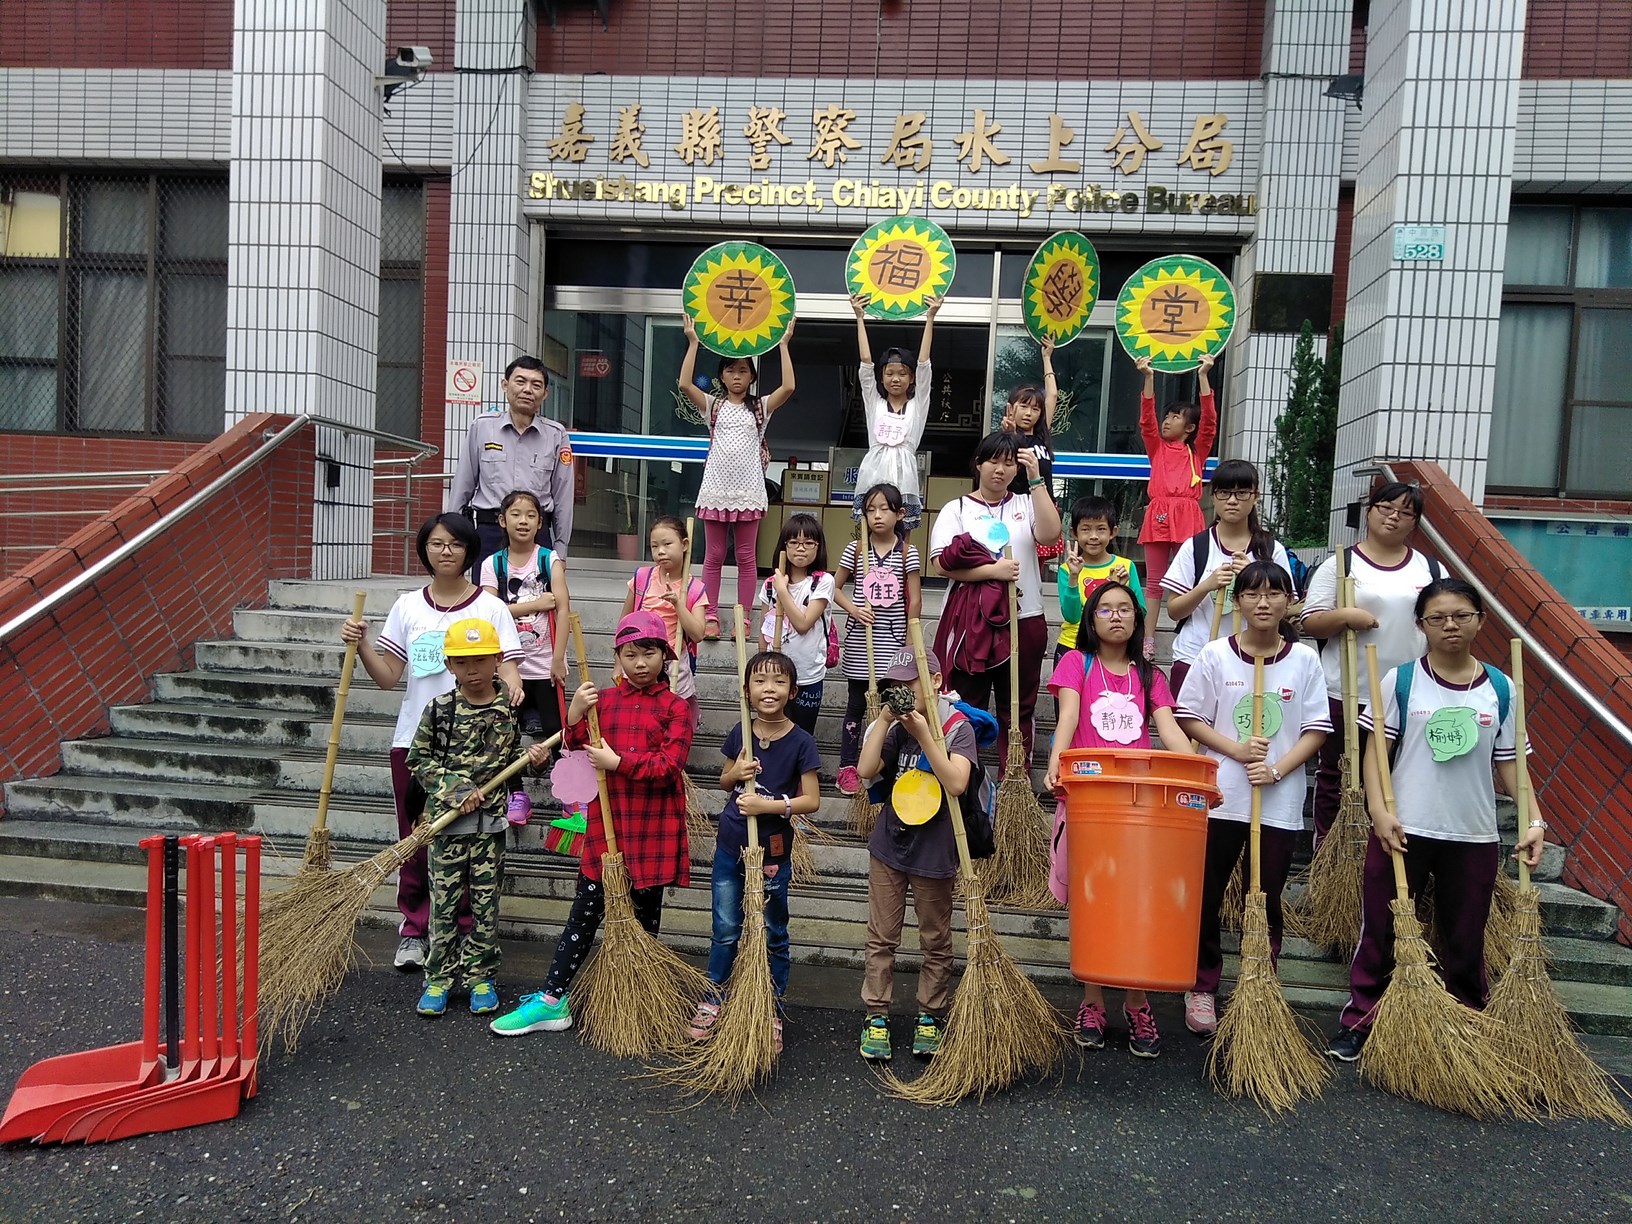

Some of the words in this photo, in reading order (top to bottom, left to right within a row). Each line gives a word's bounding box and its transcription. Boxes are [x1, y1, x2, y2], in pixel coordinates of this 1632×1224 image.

[547, 100, 1233, 176] 嘉義縣警察局水上分局
[528, 172, 687, 210] Shueishang
[694, 176, 824, 212] Precinct,
[832, 178, 924, 216] Chiayi
[930, 181, 1040, 217] County
[1047, 183, 1139, 213] Police
[1147, 185, 1256, 215] Bureau
[871, 244, 922, 289] 福
[1404, 245, 1440, 258] 528
[715, 269, 762, 324] 幸
[1151, 285, 1199, 337] 堂
